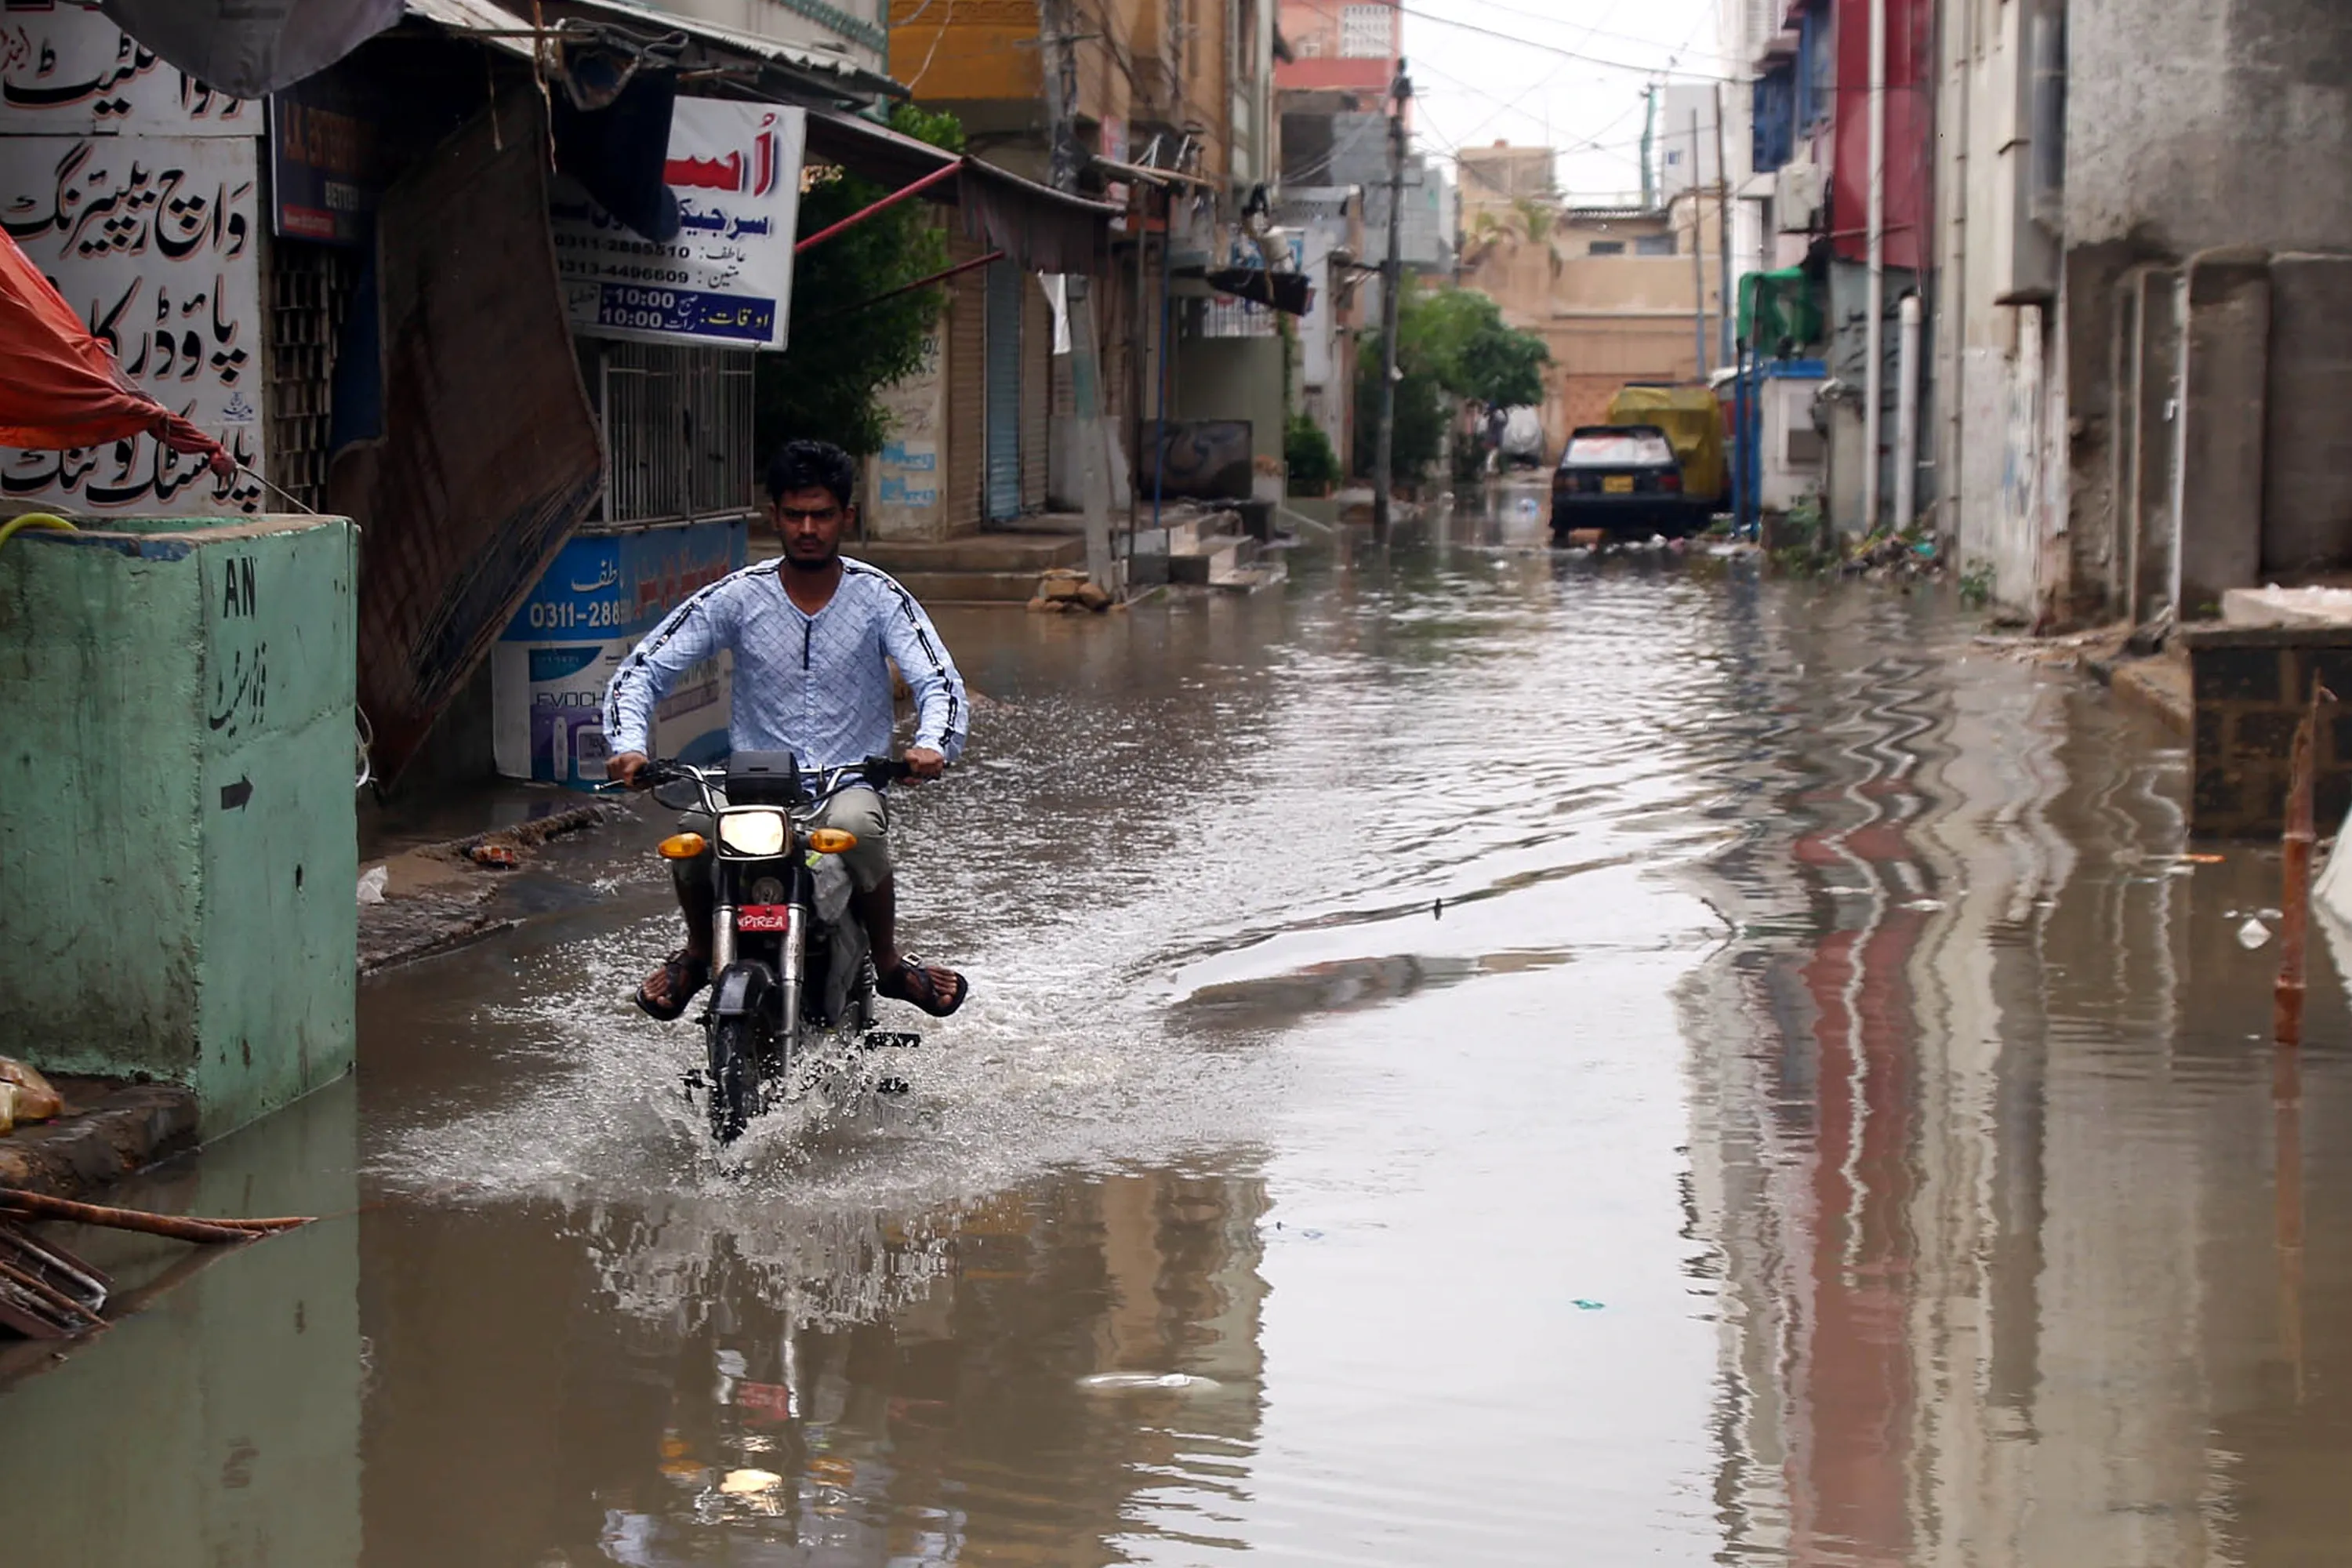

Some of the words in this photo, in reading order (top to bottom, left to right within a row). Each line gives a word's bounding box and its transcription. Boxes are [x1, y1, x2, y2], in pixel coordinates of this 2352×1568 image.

[680, 198, 770, 240] سرجیک
[615, 289, 675, 309] 10:00
[601, 308, 662, 328] 10:00
